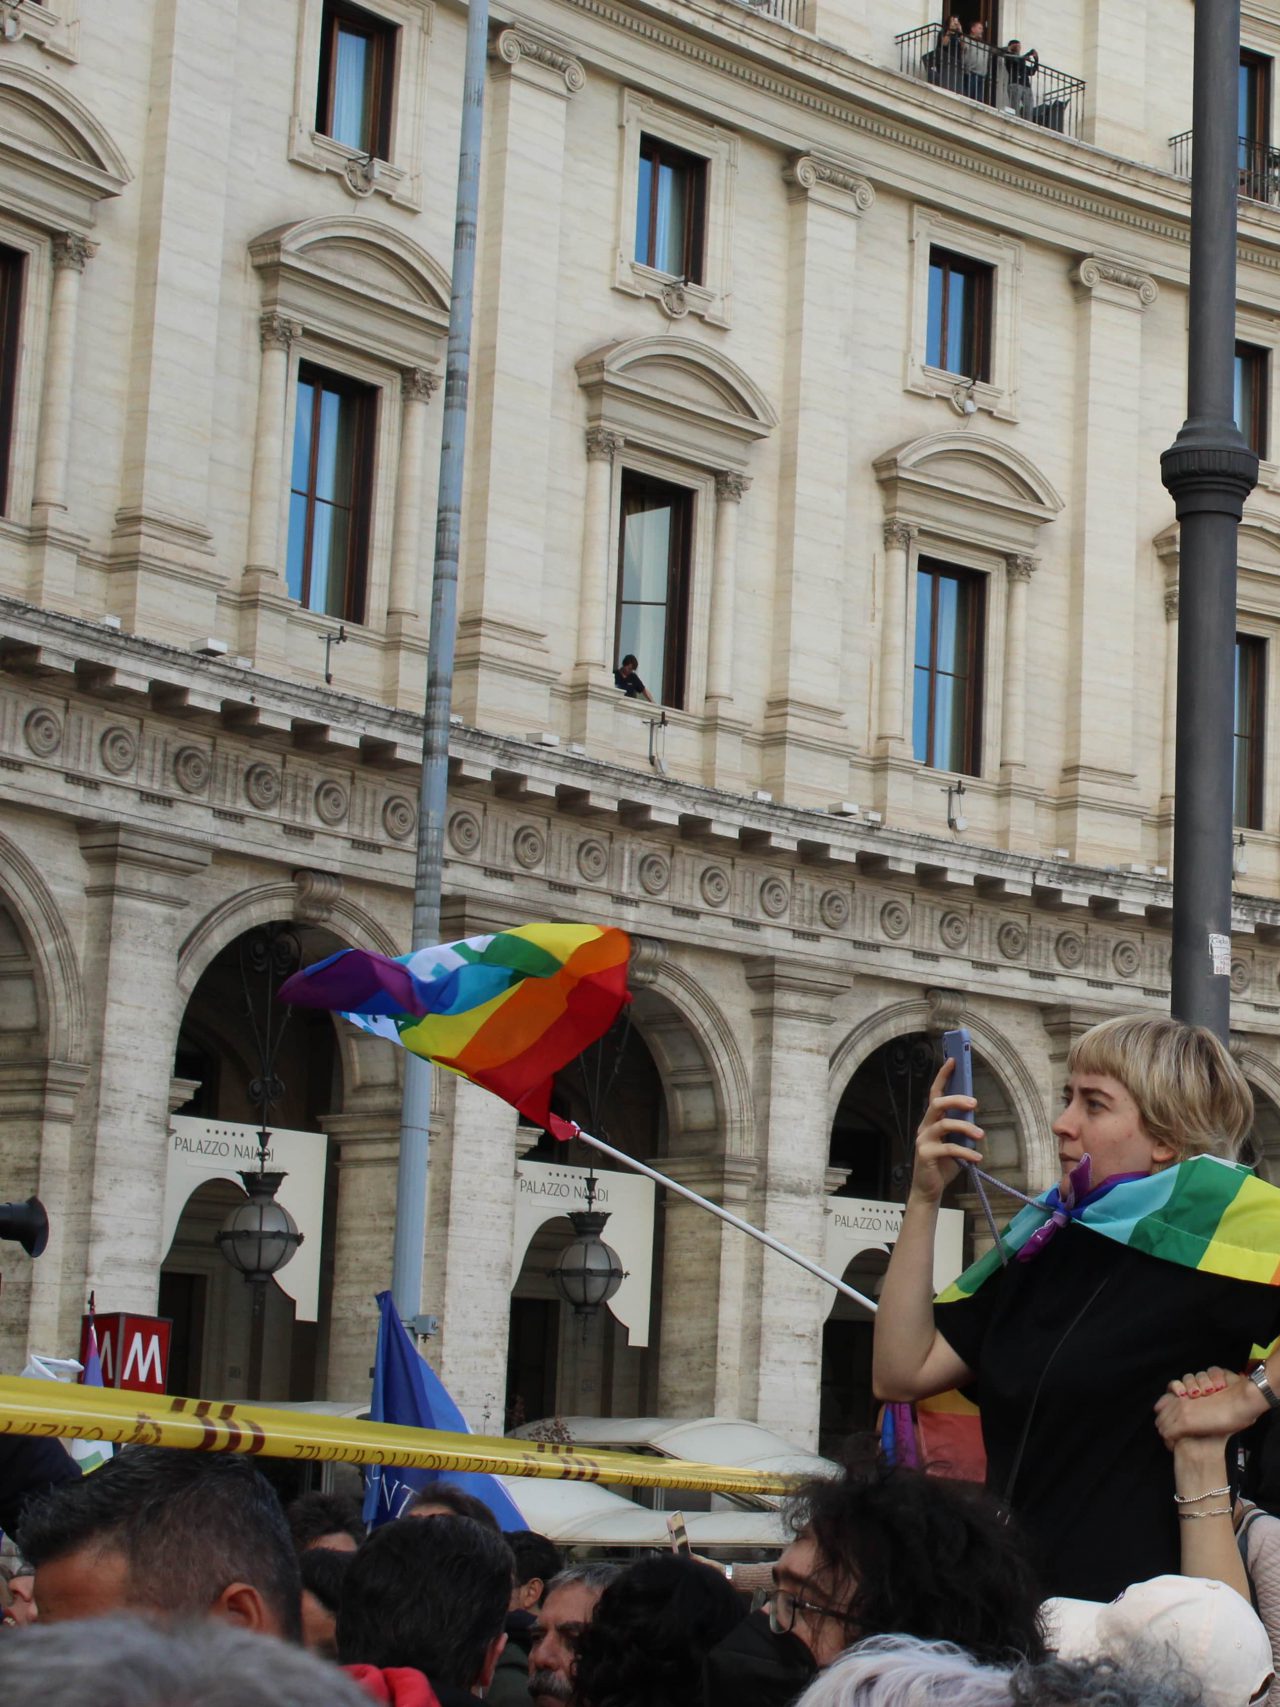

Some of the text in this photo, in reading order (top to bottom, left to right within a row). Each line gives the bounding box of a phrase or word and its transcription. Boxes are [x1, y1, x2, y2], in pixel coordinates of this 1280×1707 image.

[174, 1136, 230, 1158] PALAZZO
[520, 1178, 570, 1198] PALAZZO
[834, 1214, 882, 1231] PALAZZO
[122, 1331, 163, 1385] M
